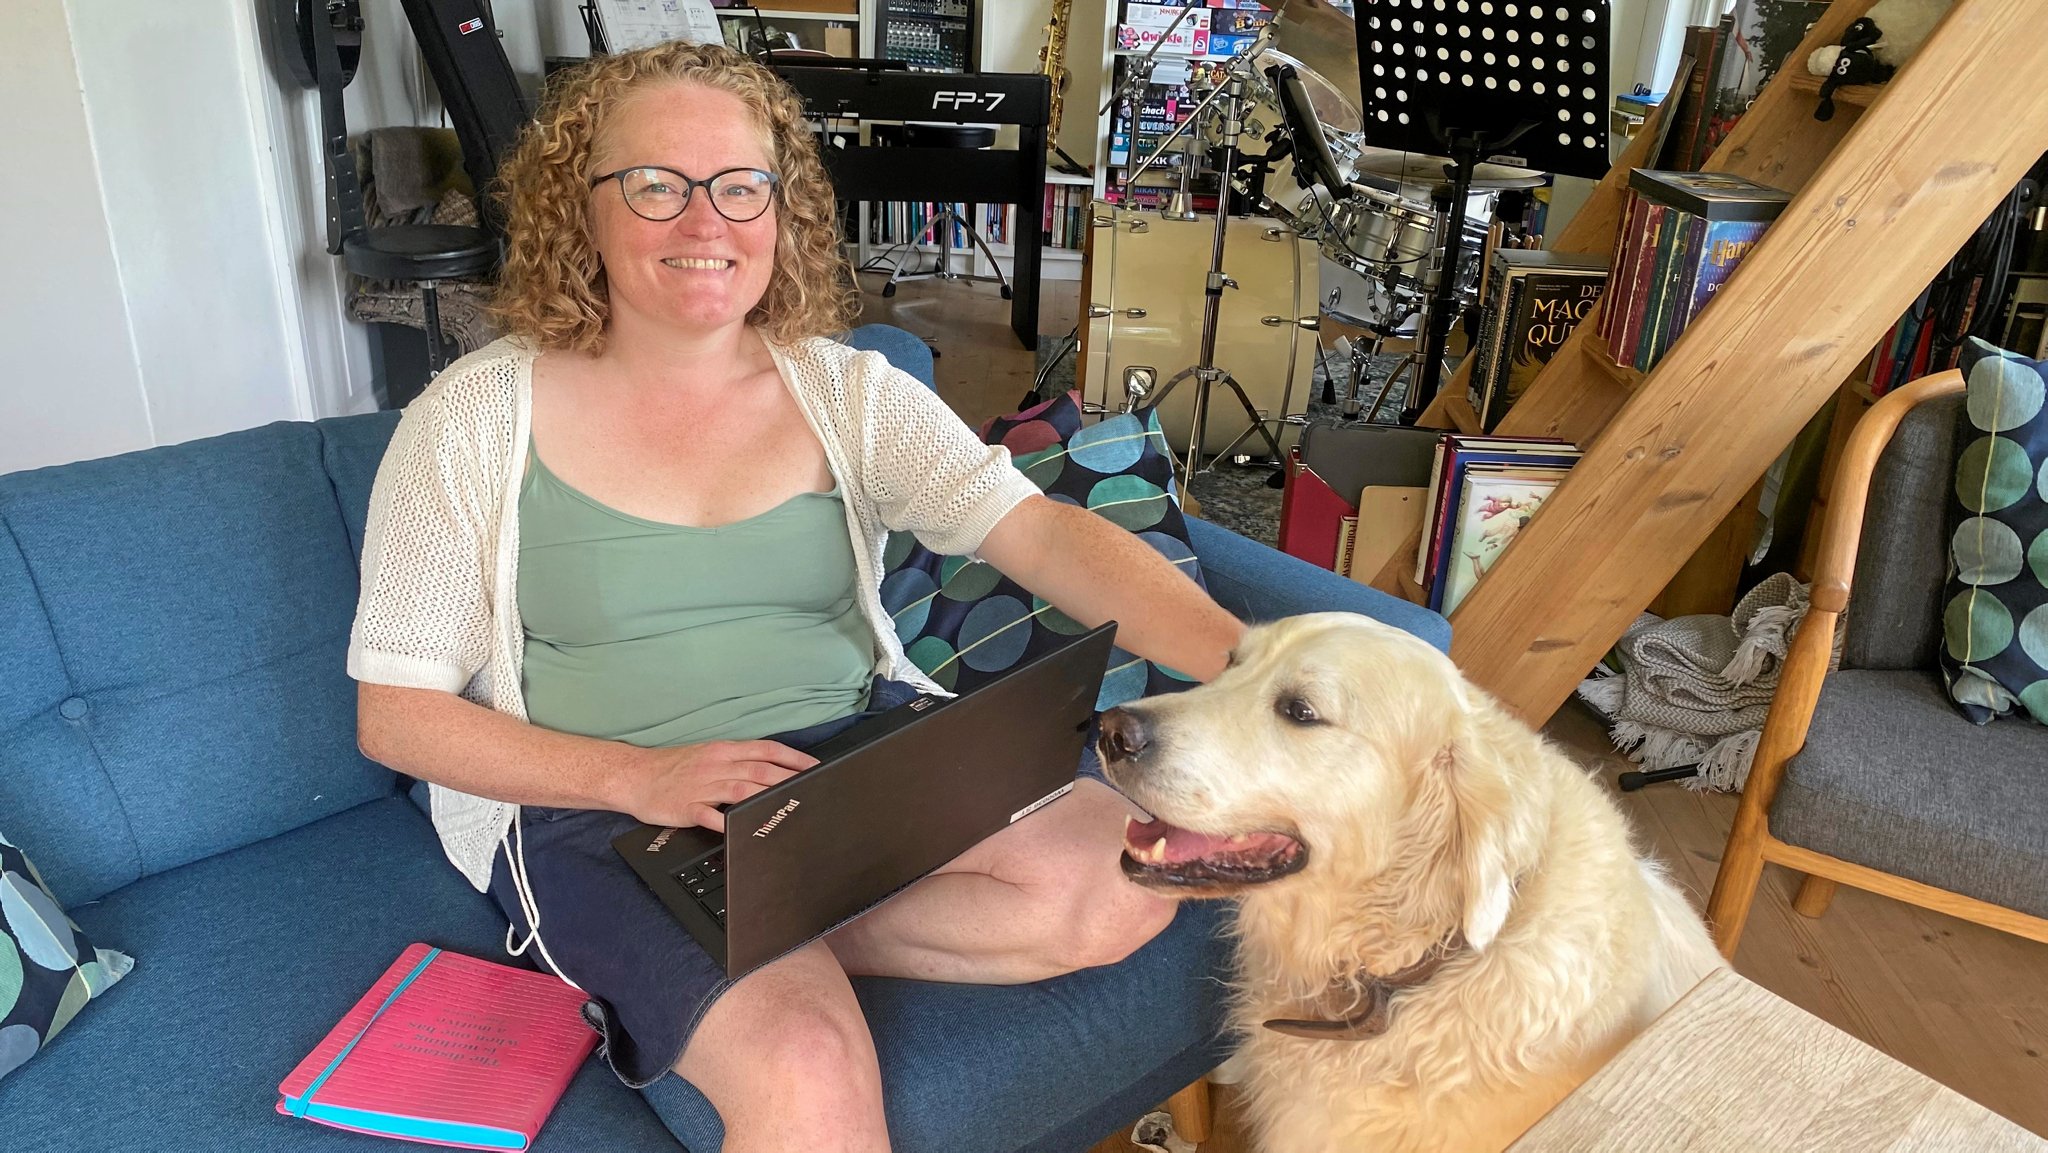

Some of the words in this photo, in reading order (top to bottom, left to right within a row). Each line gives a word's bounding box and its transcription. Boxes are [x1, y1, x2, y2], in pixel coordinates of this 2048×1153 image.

[1141, 31, 1182, 44] Qwikle
[932, 91, 1006, 111] FP-7
[1141, 105, 1165, 115] chach
[1139, 121, 1176, 132] EVERSE
[752, 799, 800, 837] ThinkPad
